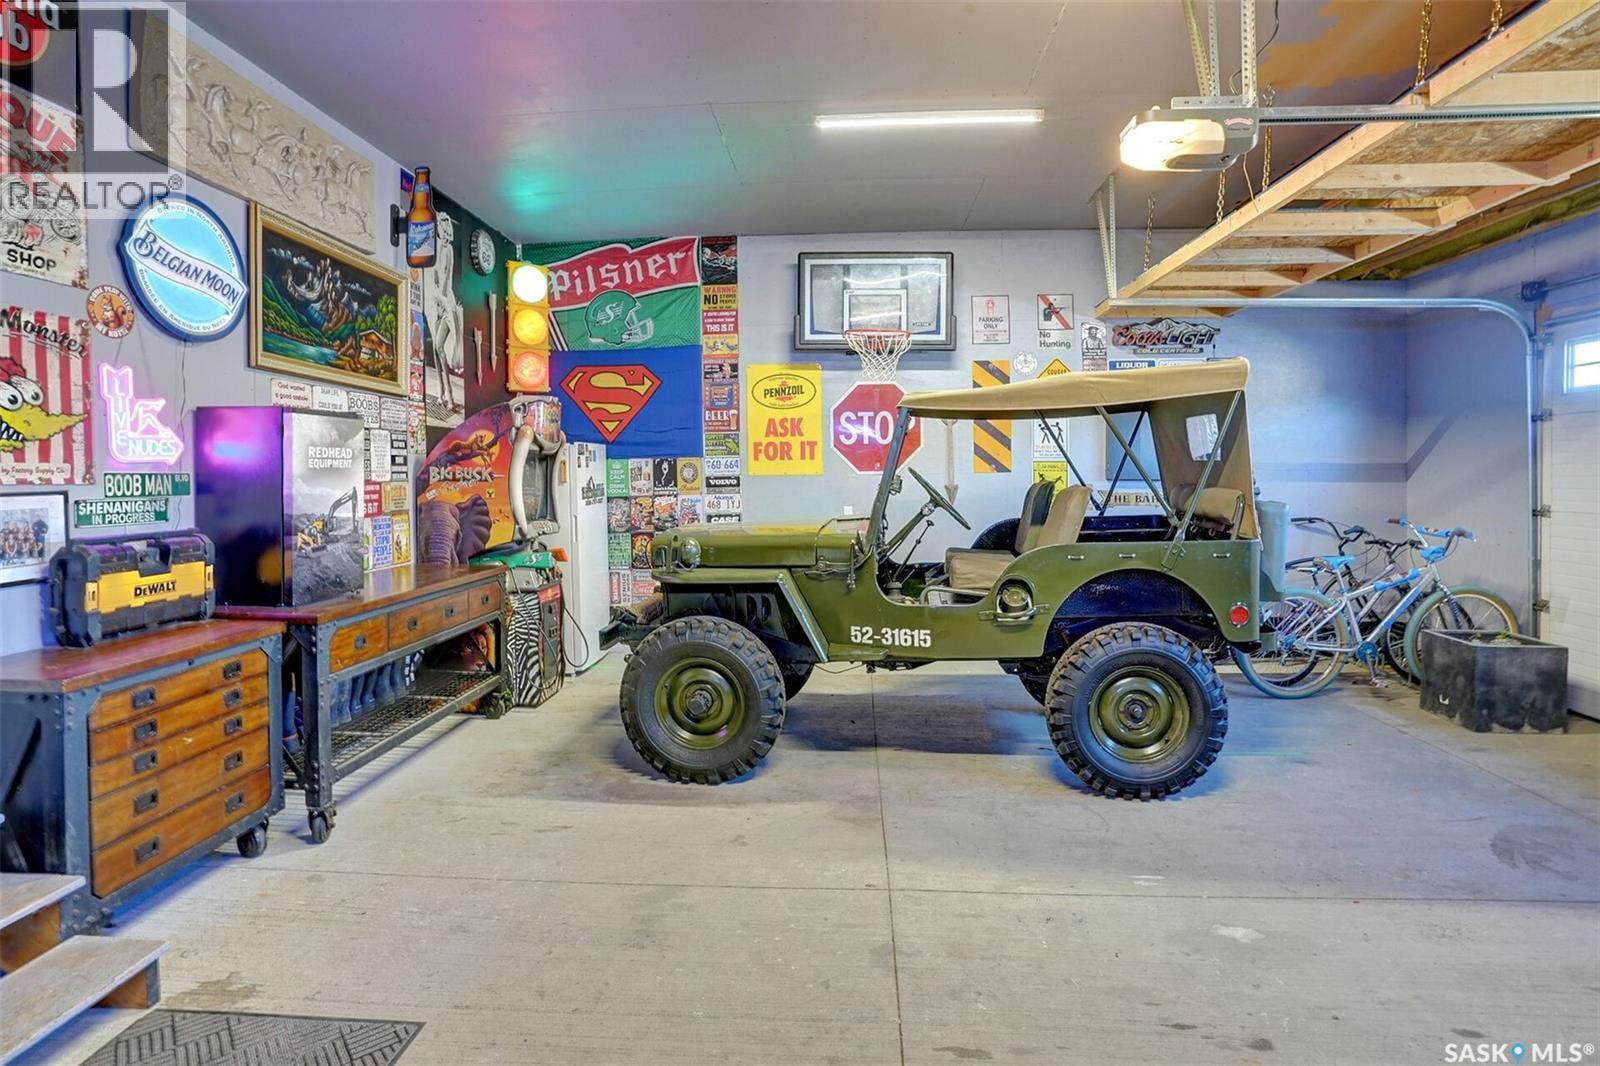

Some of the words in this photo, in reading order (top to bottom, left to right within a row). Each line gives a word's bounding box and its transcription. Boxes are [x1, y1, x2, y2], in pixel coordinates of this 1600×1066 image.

[7, 248, 57, 272] SHOP
[133, 230, 203, 283] BELGIAN
[200, 269, 241, 305] MOON
[547, 251, 688, 302] Pilsner
[704, 294, 718, 305] NO
[706, 324, 720, 332] THIS
[721, 324, 727, 332] IS
[1039, 331, 1051, 339] No
[1164, 329, 1217, 345] LIGHT
[1039, 340, 1071, 350] Hunting
[1115, 361, 1148, 369] LIQUOR
[763, 384, 805, 399] PENNZOIL
[349, 397, 380, 412] BOOBS
[705, 409, 729, 421] BEER
[764, 416, 804, 438] ASK
[129, 439, 177, 458] NUDES
[308, 446, 353, 460] REDHEAD
[752, 444, 793, 462] FOR
[799, 443, 818, 461] IT
[308, 458, 352, 469] EQUIPMENT
[429, 463, 454, 485] BIG
[104, 475, 143, 497] BOOB
[144, 474, 172, 495] MAN
[1108, 495, 1130, 503] HE
[78, 500, 166, 516] SHENANIGANS
[92, 513, 102, 524] IN
[104, 511, 156, 524] PROGRESS
[850, 625, 932, 648] 52-31615
